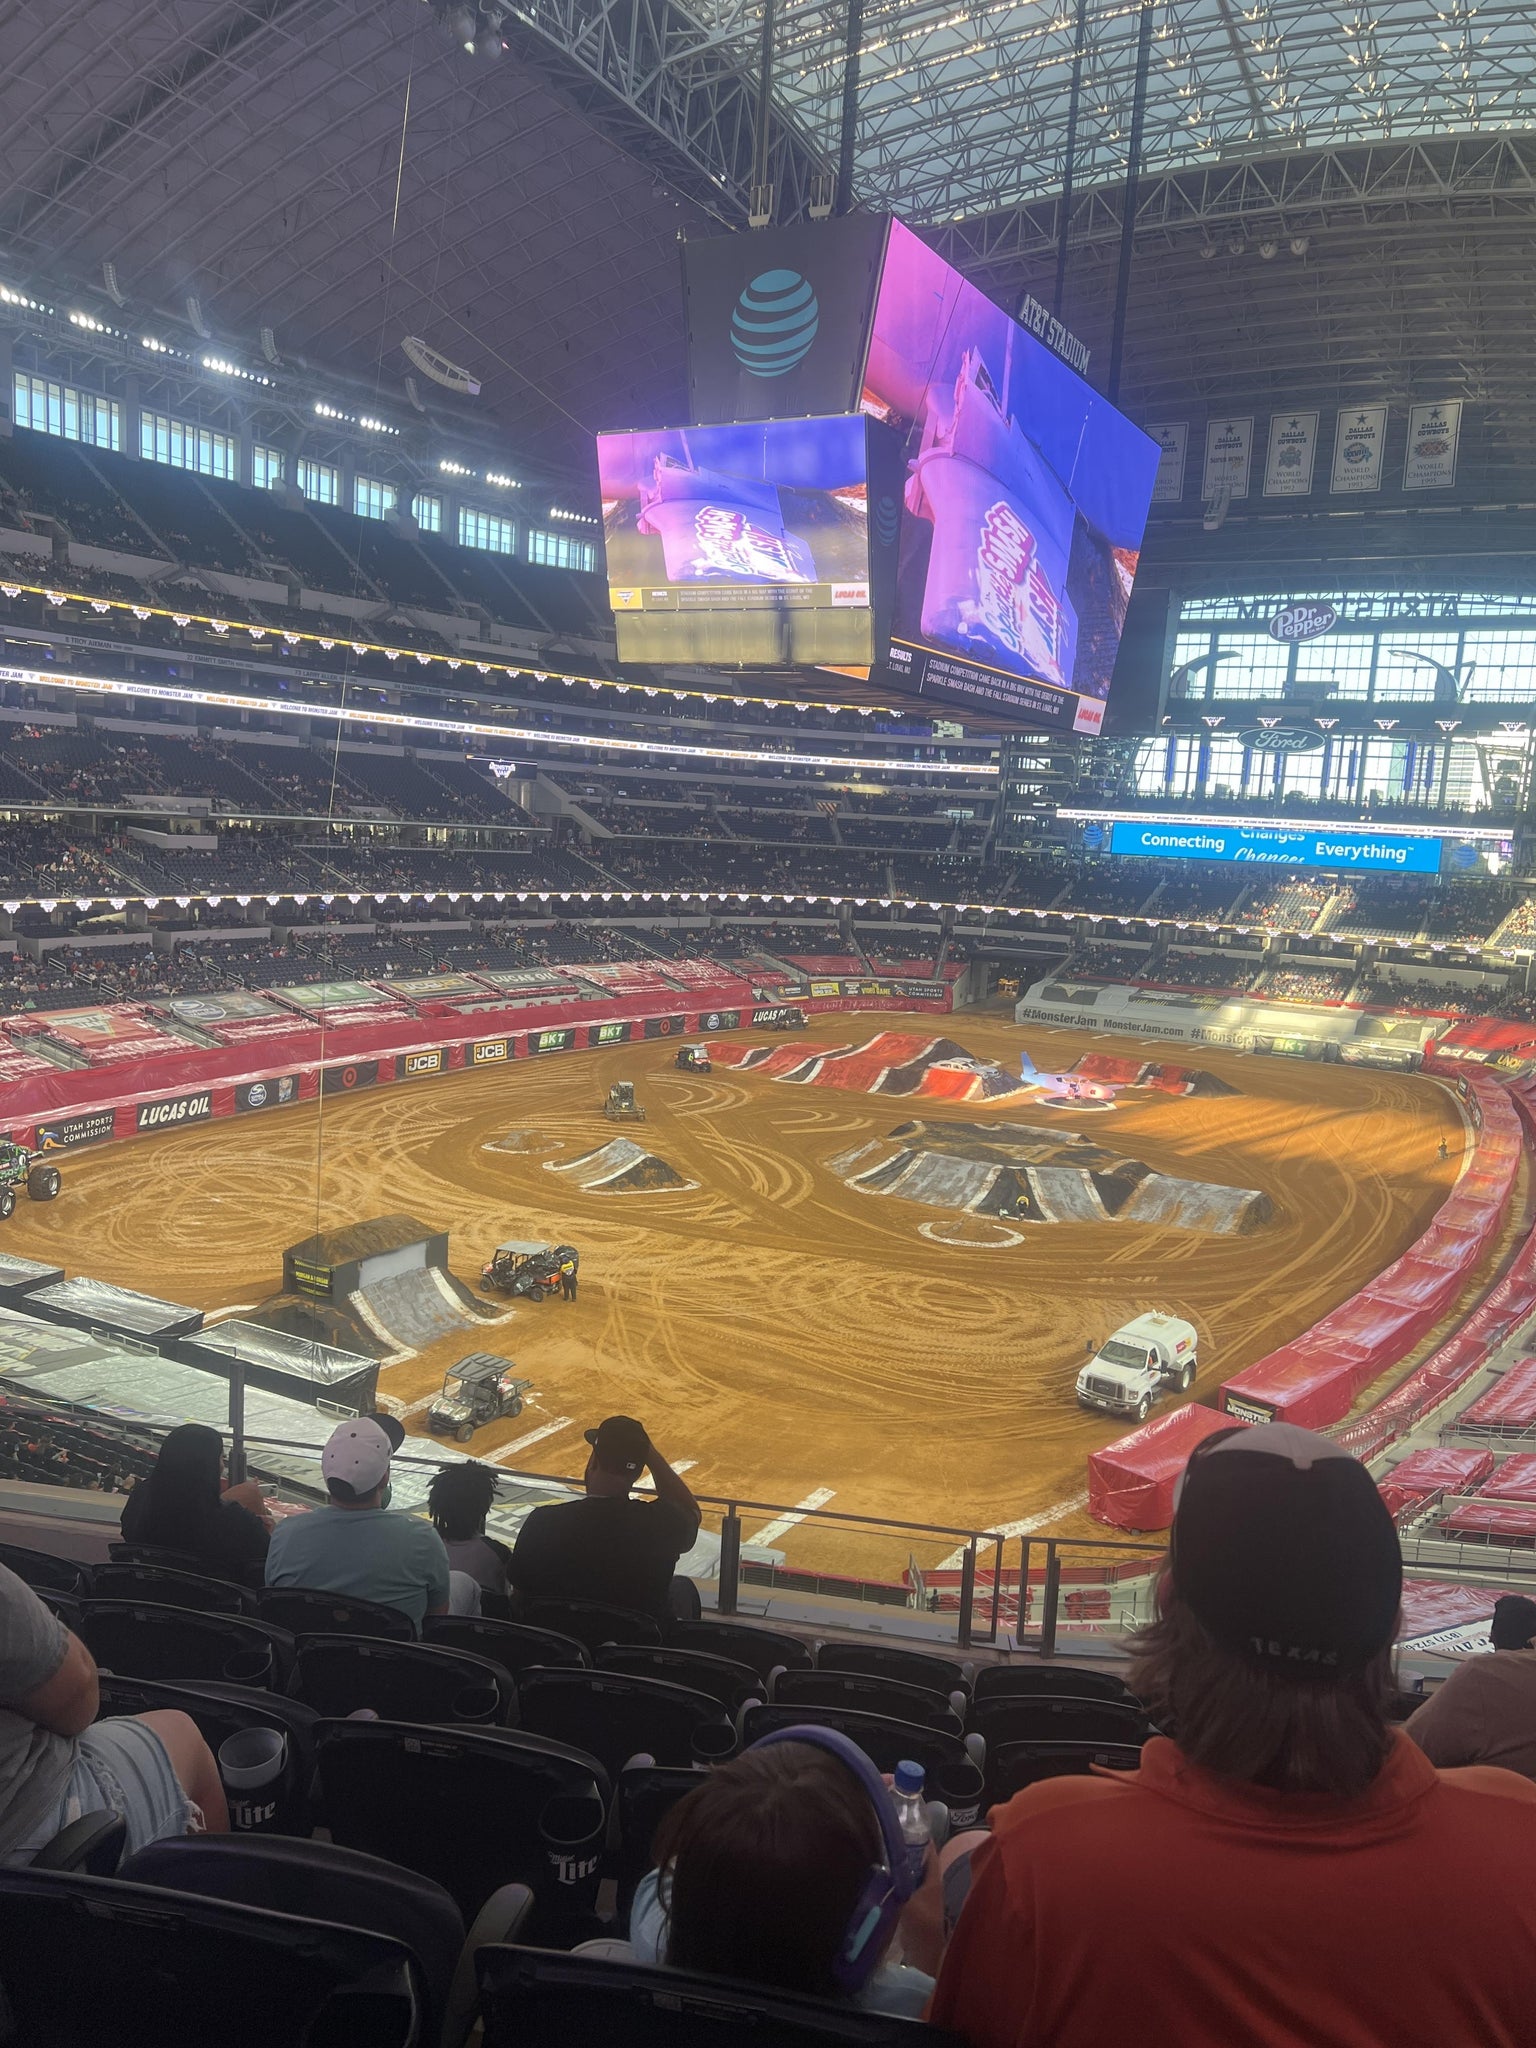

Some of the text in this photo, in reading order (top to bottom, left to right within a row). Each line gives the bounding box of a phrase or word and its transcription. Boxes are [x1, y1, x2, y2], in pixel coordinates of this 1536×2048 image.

[1019, 294, 1091, 375] AT&T STADIUM
[1348, 426, 1373, 434] DALLAS
[1417, 428, 1449, 436] COWBOYS
[1421, 421, 1448, 429] DALLAS
[1345, 433, 1376, 441] COWBOYS
[1214, 442, 1242, 450] COWBOYS
[1335, 474, 1377, 482] CHAMPIONS
[1408, 470, 1451, 478] CHAMPIONS
[1267, 478, 1308, 486] CHAMPIONS
[982, 504, 1030, 582] SMASH
[1293, 606, 1317, 623] Dr
[1276, 611, 1332, 639] Pepper
[88, 640, 112, 649] AIKMAN
[890, 648, 912, 662] RESULTS
[10, 671, 23, 679] JAM
[929, 659, 950, 672] STADIUM
[950, 666, 979, 680] COMPETITION
[979, 673, 991, 685] CAME
[991, 677, 1001, 688] BACK
[39, 675, 66, 685] WELCOME
[75, 680, 100, 689] MONSTER
[927, 673, 947, 686] SPARKLE
[947, 679, 963, 689] SMASH
[963, 682, 975, 693] BASH
[976, 686, 984, 695] AND
[985, 688, 993, 698] THE
[1003, 693, 1019, 705] STADIUM
[127, 686, 151, 695] WELCOME
[159, 689, 182, 698] MONSTER
[281, 704, 301, 712] WELCOME
[308, 707, 327, 715] MONSTER
[1255, 730, 1308, 749] Ford
[1141, 832, 1225, 853] Connecting
[490, 973, 535, 983] LUCAS
[752, 1009, 778, 1023] LUCAS
[1022, 1008, 1097, 1028] #MonsterJam
[598, 1026, 622, 1040] BKT
[1103, 1018, 1184, 1037] MonsterJam.com
[539, 1032, 565, 1047] BKT
[476, 1044, 504, 1060] JCB
[408, 1055, 438, 1071] JCB
[139, 1096, 209, 1126] LUCAS OIL
[63, 1115, 113, 1133] UTAH SPORTS
[63, 1126, 112, 1143] COMMISSION
[1226, 1404, 1271, 1424] MONSTER
[1433, 1631, 1463, 1643] (817)
[1249, 1636, 1338, 1666] TEXAS
[233, 1800, 276, 1829] Lite
[549, 1851, 575, 1863] Miller
[558, 1855, 599, 1886] Lite
